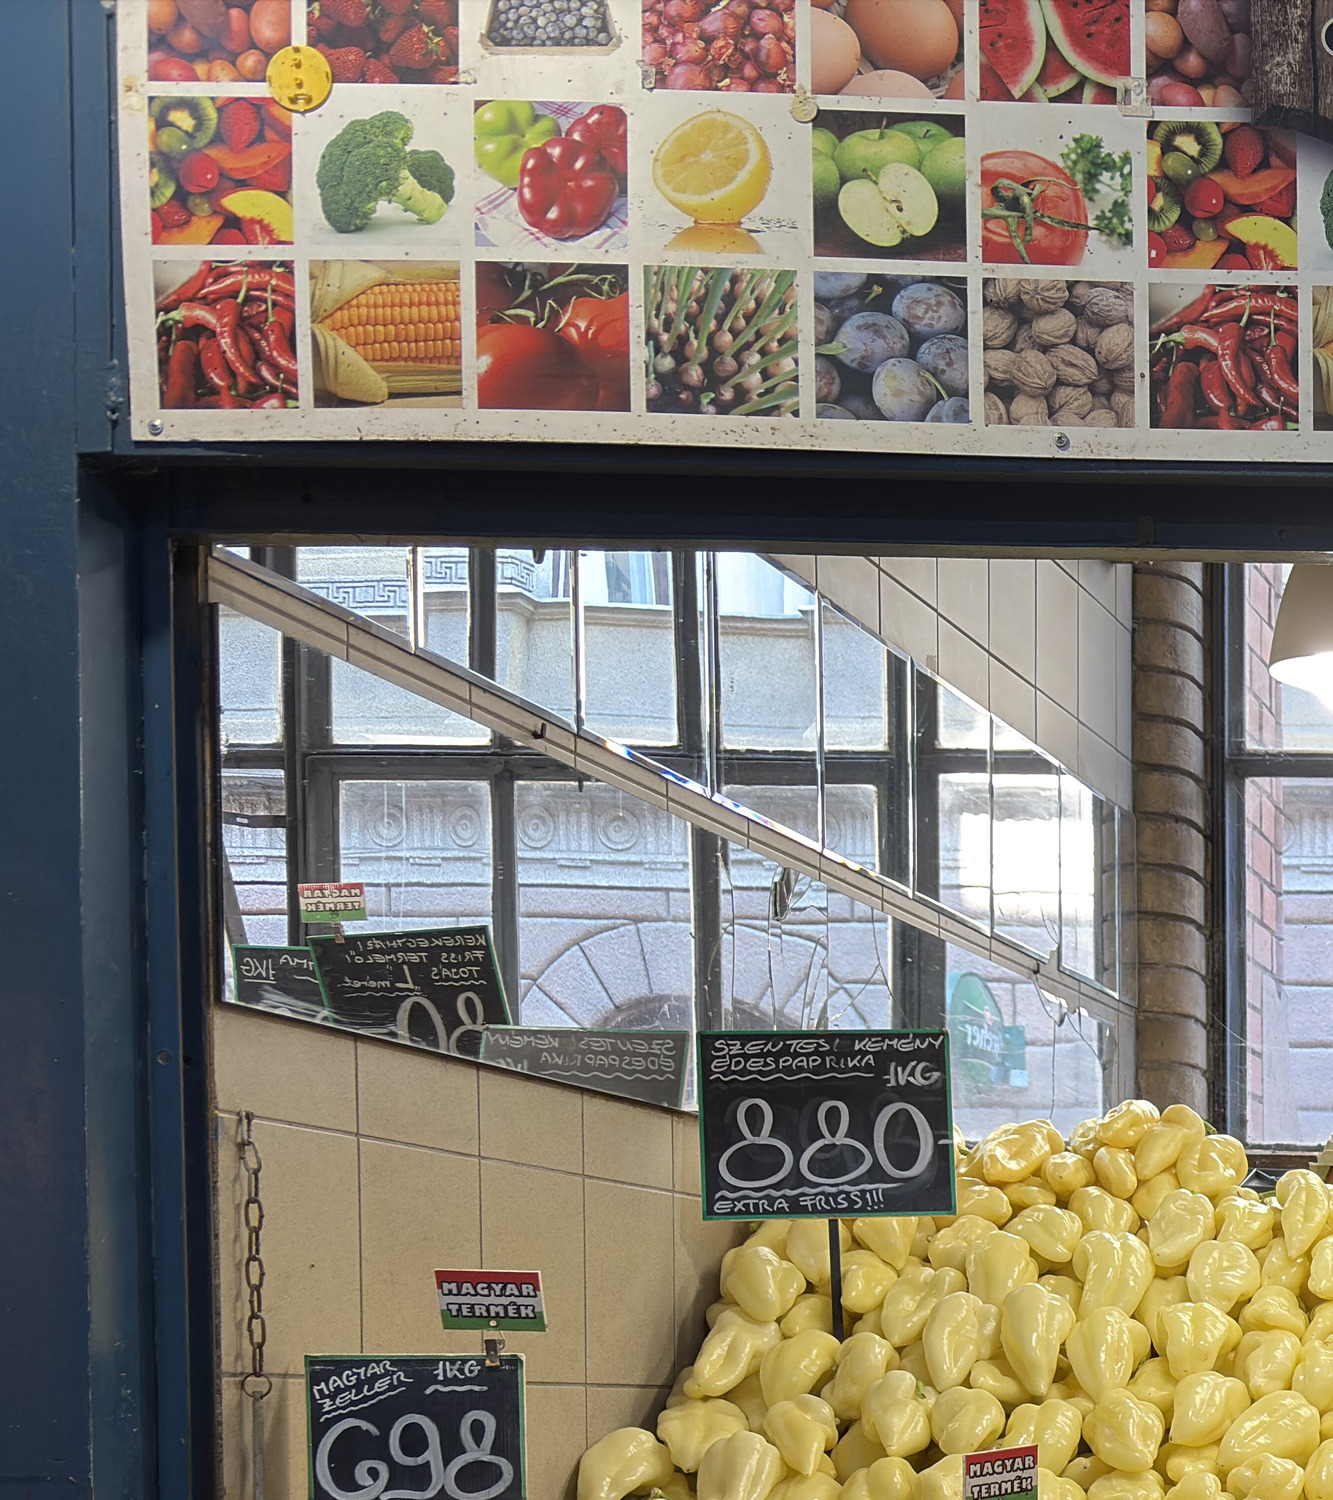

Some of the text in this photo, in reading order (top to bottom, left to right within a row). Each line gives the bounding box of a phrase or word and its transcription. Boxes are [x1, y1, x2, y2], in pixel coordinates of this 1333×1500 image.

[711, 1033, 944, 1056] SZENTESI KEMÉNY
[710, 1053, 941, 1087] ÉDESPAPRIKA 1KG
[714, 1199, 789, 1213] EXTRA
[441, 1281, 537, 1297] MAGYAR
[447, 1302, 536, 1319] TERMÉK
[312, 1360, 481, 1399] MAGYAR 1KG
[318, 1371, 413, 1411] ZELLER
[969, 1455, 1035, 1478] MAGYAR
[971, 1476, 1033, 1499] TERMÉK
